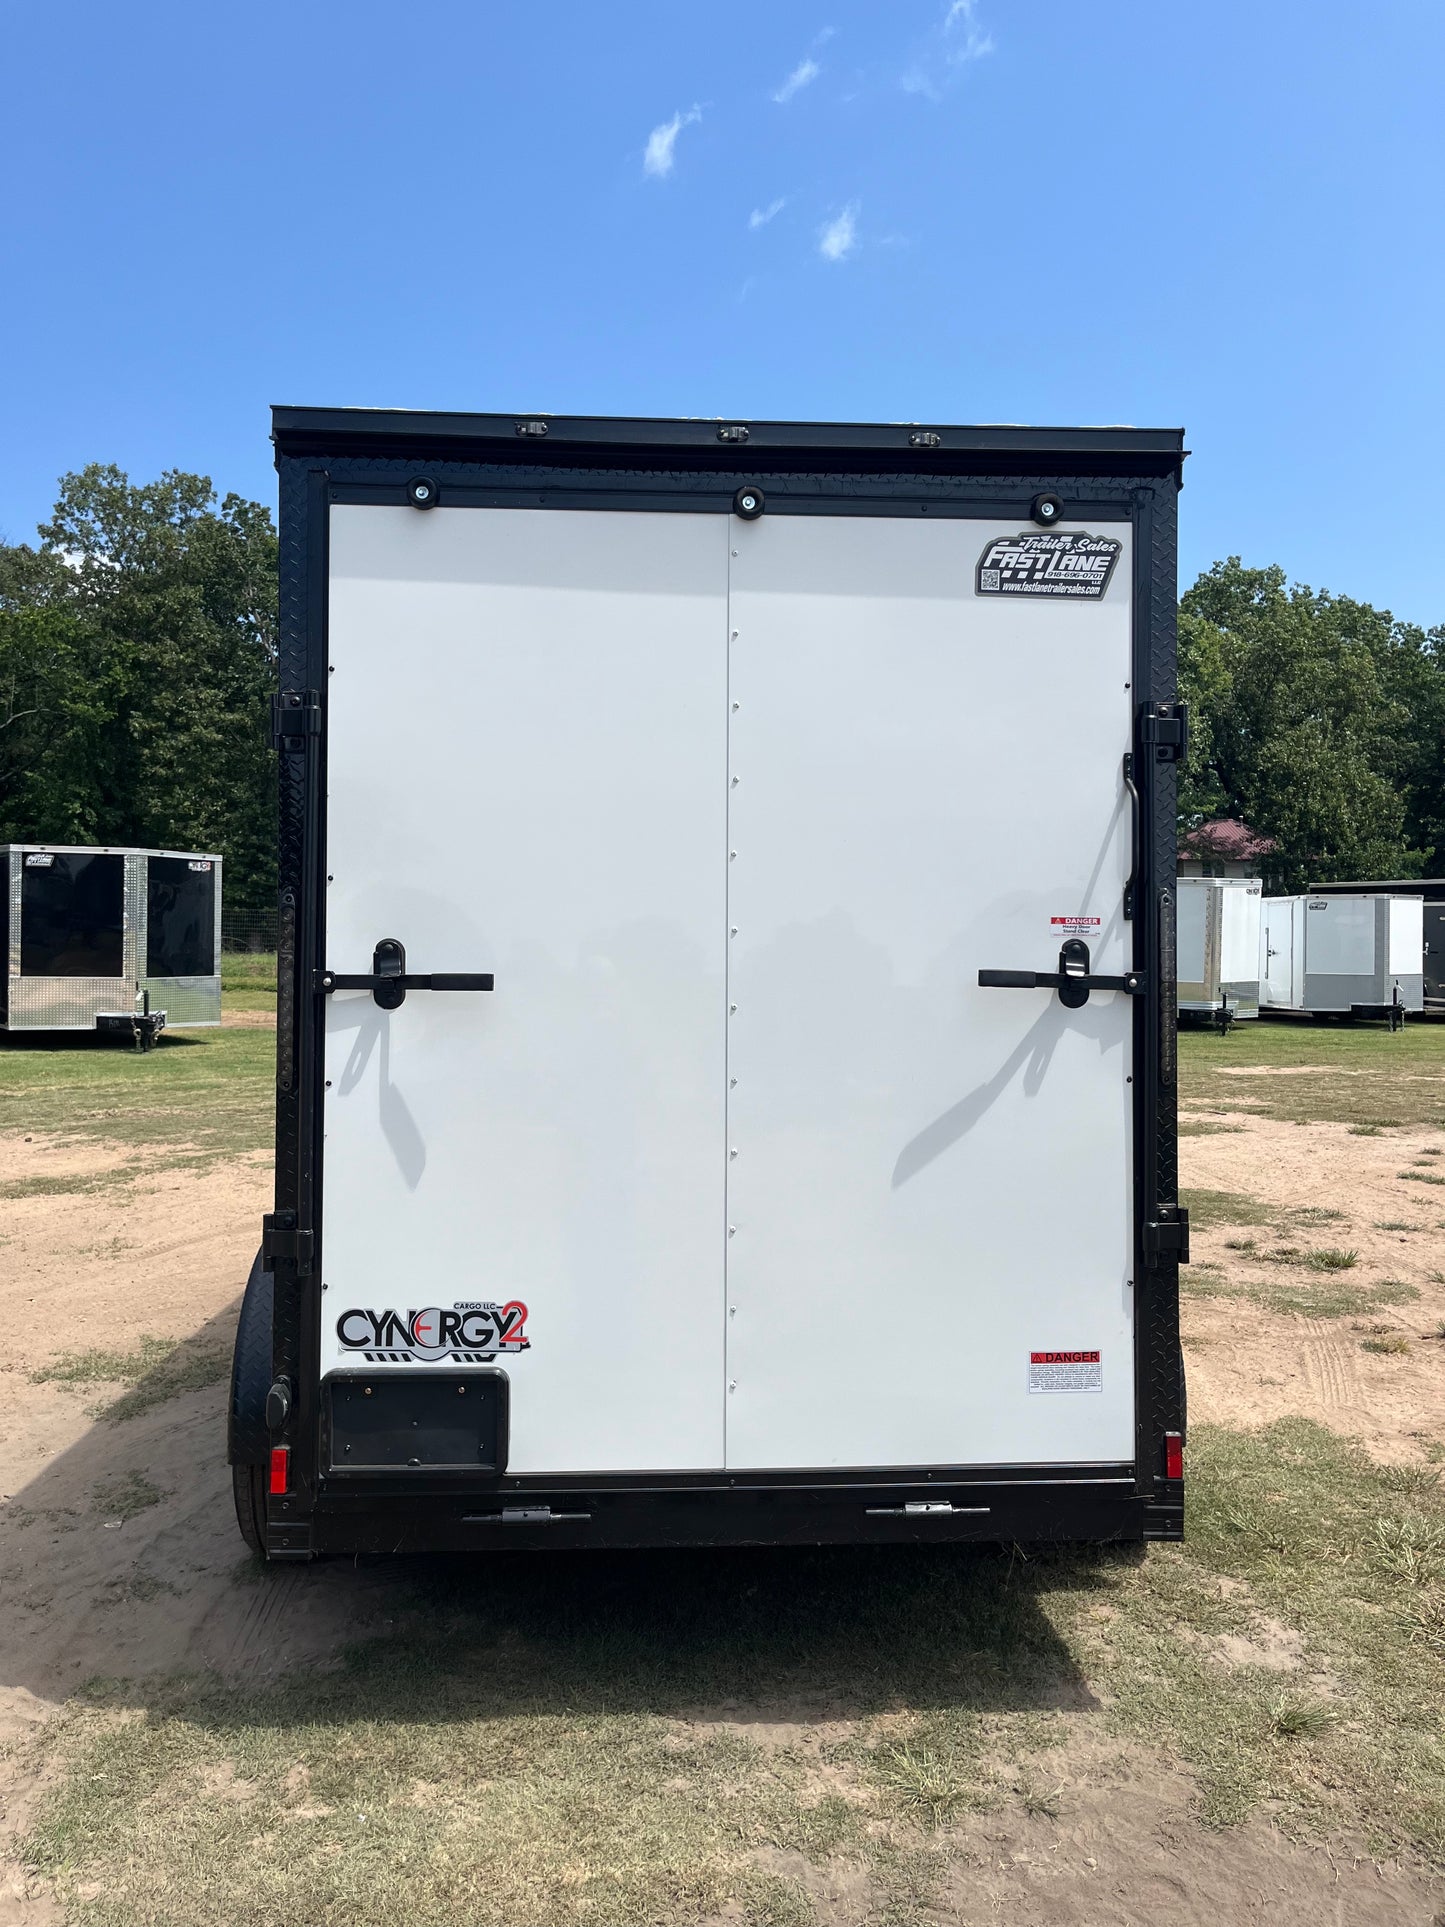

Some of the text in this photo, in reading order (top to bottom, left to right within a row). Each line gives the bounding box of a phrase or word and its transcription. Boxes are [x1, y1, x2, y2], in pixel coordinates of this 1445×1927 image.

[1023, 536, 1117, 552] Trailer Sales
[1047, 571, 1103, 579] 918-696-0701
[1002, 582, 1100, 595] www.fastlanetrailersales.com
[1065, 917, 1098, 925] DANGER
[453, 1302, 496, 1310] CARGO LLC
[1045, 1352, 1098, 1363] DANGER
